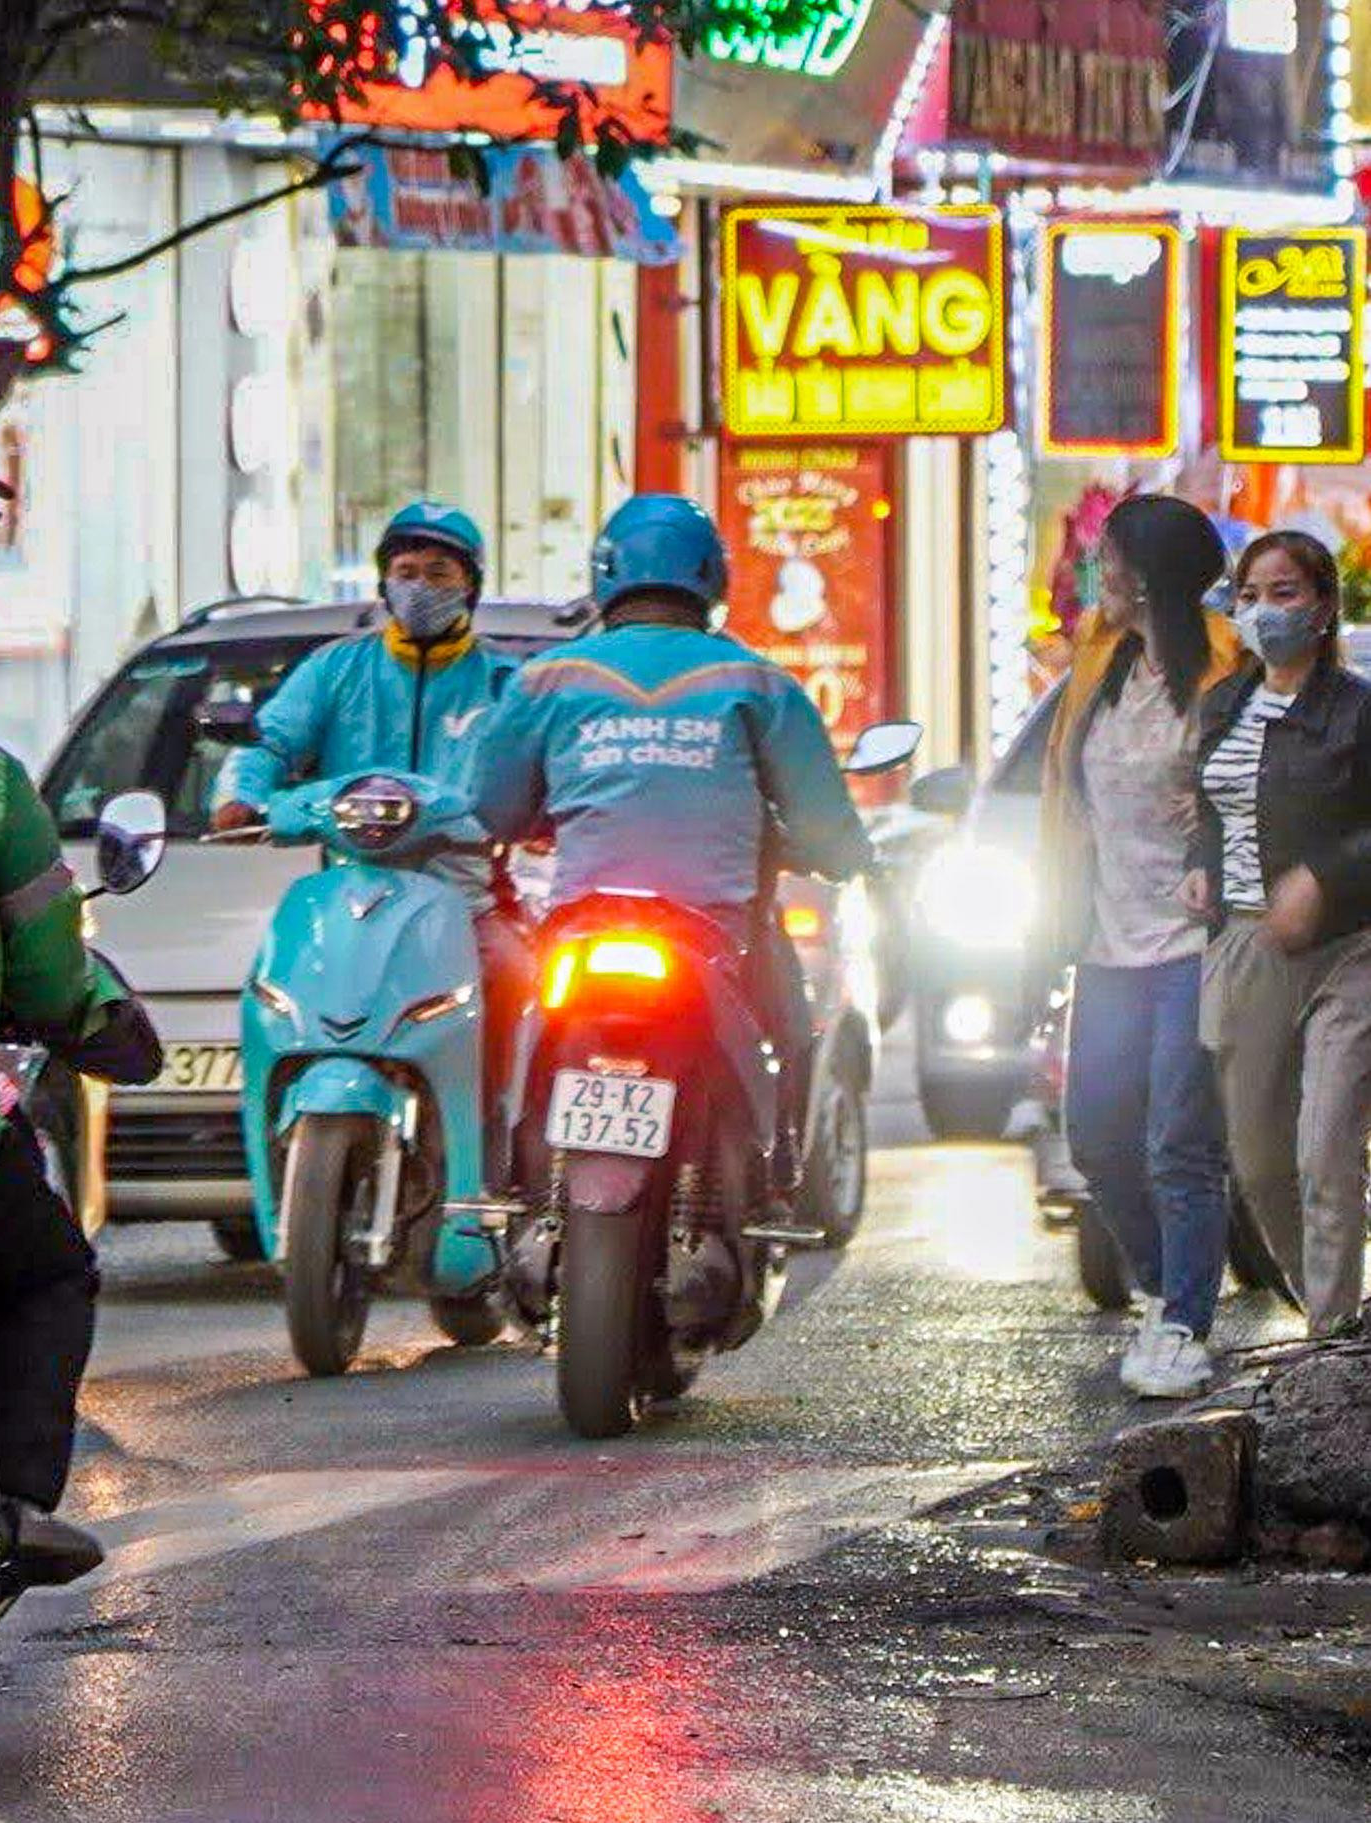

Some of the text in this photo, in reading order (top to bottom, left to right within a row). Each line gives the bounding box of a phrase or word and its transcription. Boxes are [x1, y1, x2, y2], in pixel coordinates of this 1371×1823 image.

[578, 716, 723, 744] XANH SM
[571, 1077, 656, 1116] 29-K2
[561, 1110, 661, 1150] 137.52
